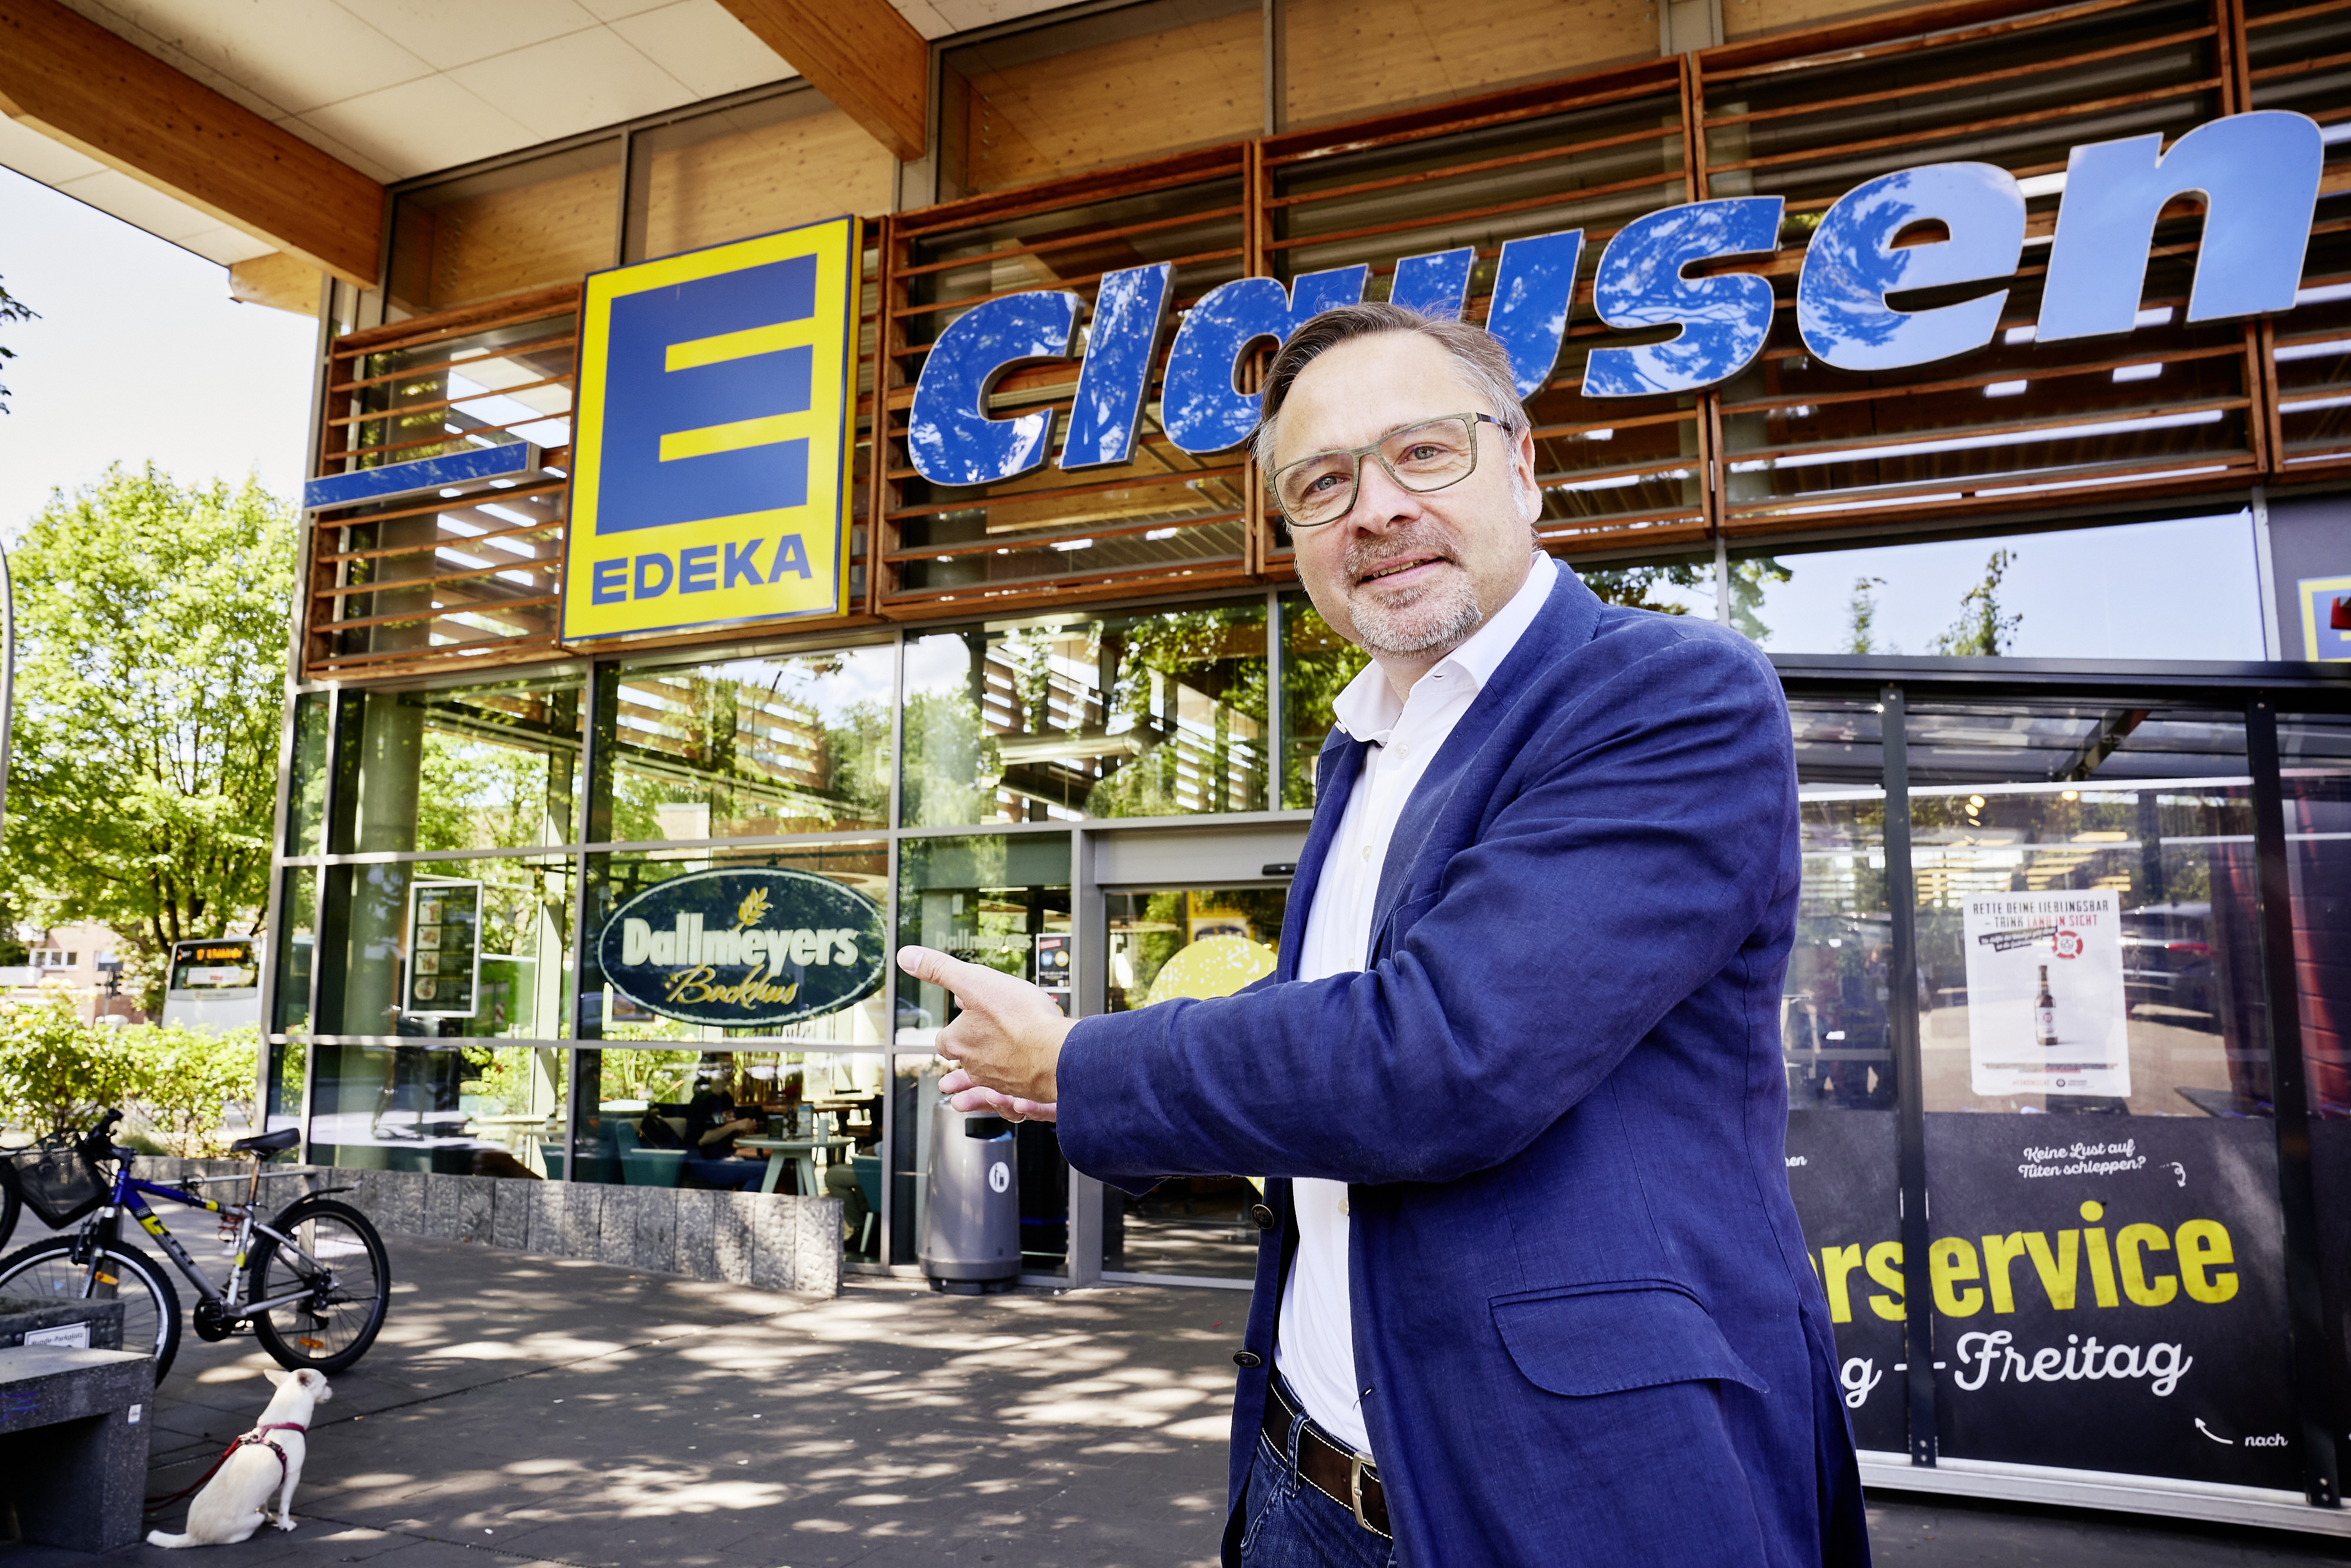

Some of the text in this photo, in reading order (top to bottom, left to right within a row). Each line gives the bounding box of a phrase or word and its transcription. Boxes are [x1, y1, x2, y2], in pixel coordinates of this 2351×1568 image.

[908, 109, 2324, 487] clausen
[591, 534, 812, 606] EDEKA
[1973, 900, 2109, 914] RETTE DEINE LIEBLINGSBAR
[1995, 916, 2024, 928] TRINK
[2027, 915, 2052, 928] LAND
[2055, 915, 2065, 926] IN
[2069, 914, 2097, 927] SICHT
[622, 912, 859, 977] Dallmeyers
[2023, 1138, 2136, 1163] Keine Lust auf
[2018, 1155, 2147, 1179] Tüten schleppen?
[1954, 1330, 2193, 1397] Freitag
[2244, 1432, 2288, 1447] nach
